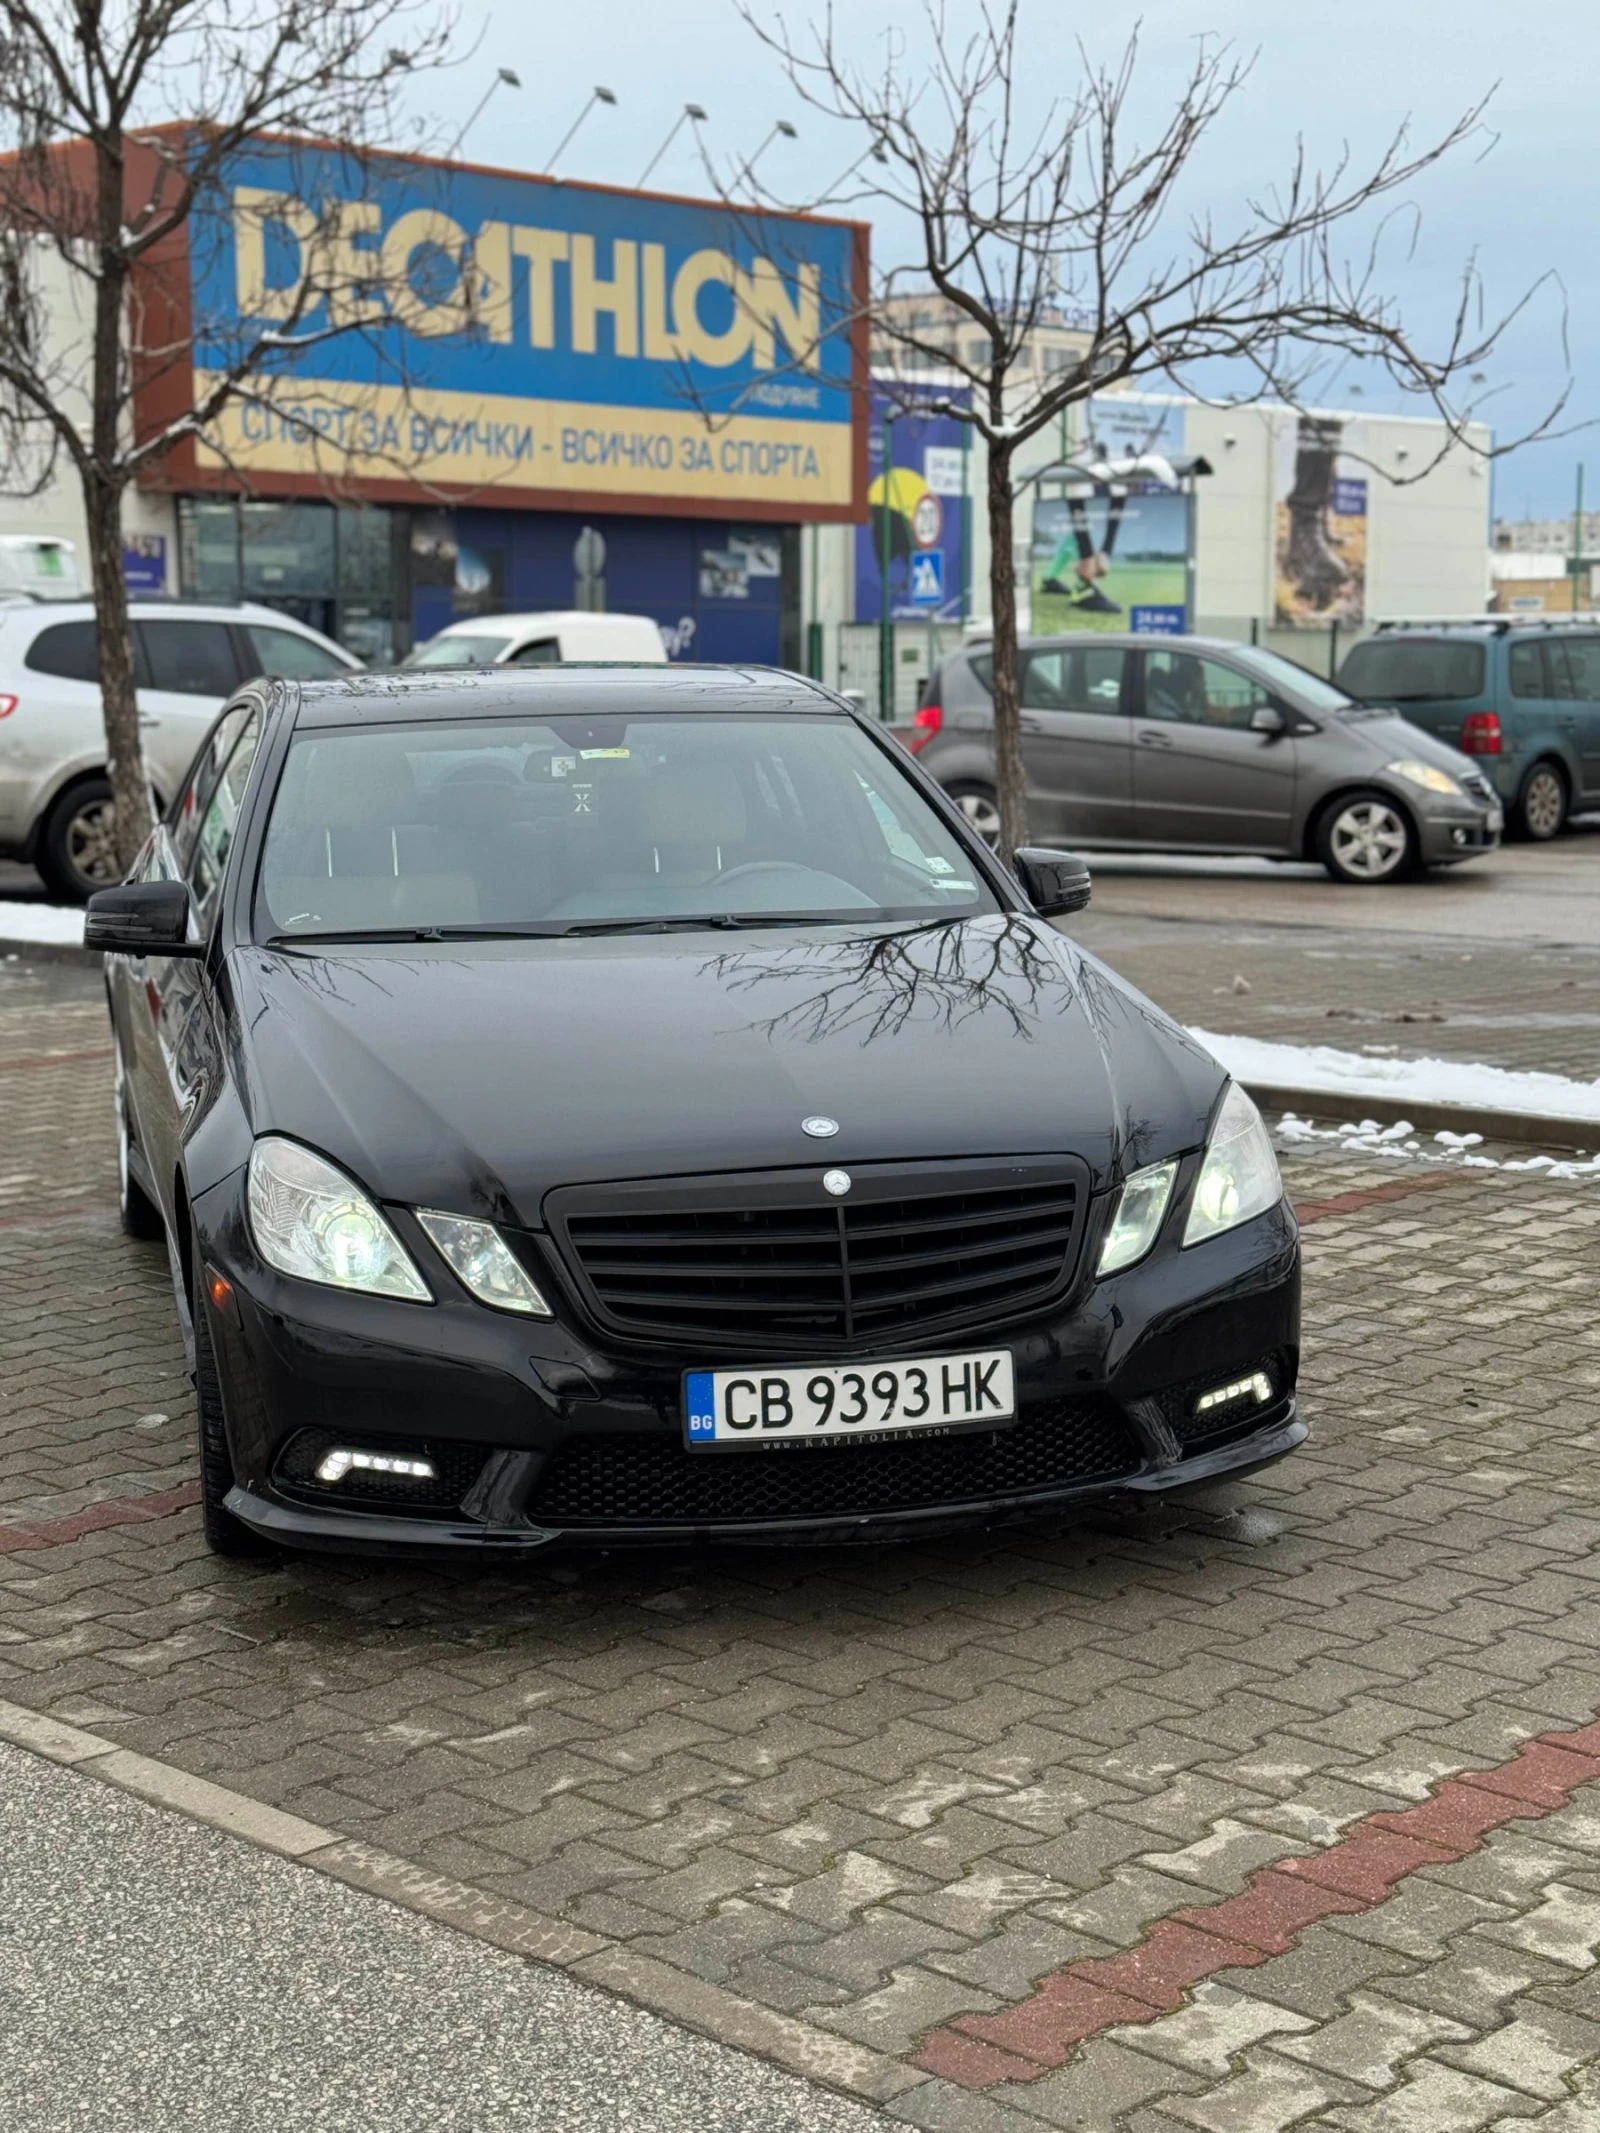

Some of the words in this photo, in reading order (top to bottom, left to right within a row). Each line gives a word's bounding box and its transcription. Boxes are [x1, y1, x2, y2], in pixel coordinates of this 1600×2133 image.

[234, 186, 820, 371] DECATHLON
[241, 402, 352, 445] СПОРТ
[359, 411, 400, 450] ЗА
[409, 415, 533, 460] ВСИЧКИ
[562, 428, 673, 470] ВСИЧКО
[679, 436, 715, 473] ЗА
[720, 439, 820, 478] СПОРТА
[689, 1415, 713, 1431] BG
[725, 1378, 793, 1430] CB
[806, 1367, 930, 1426] 9393
[942, 1359, 1003, 1415] HK
